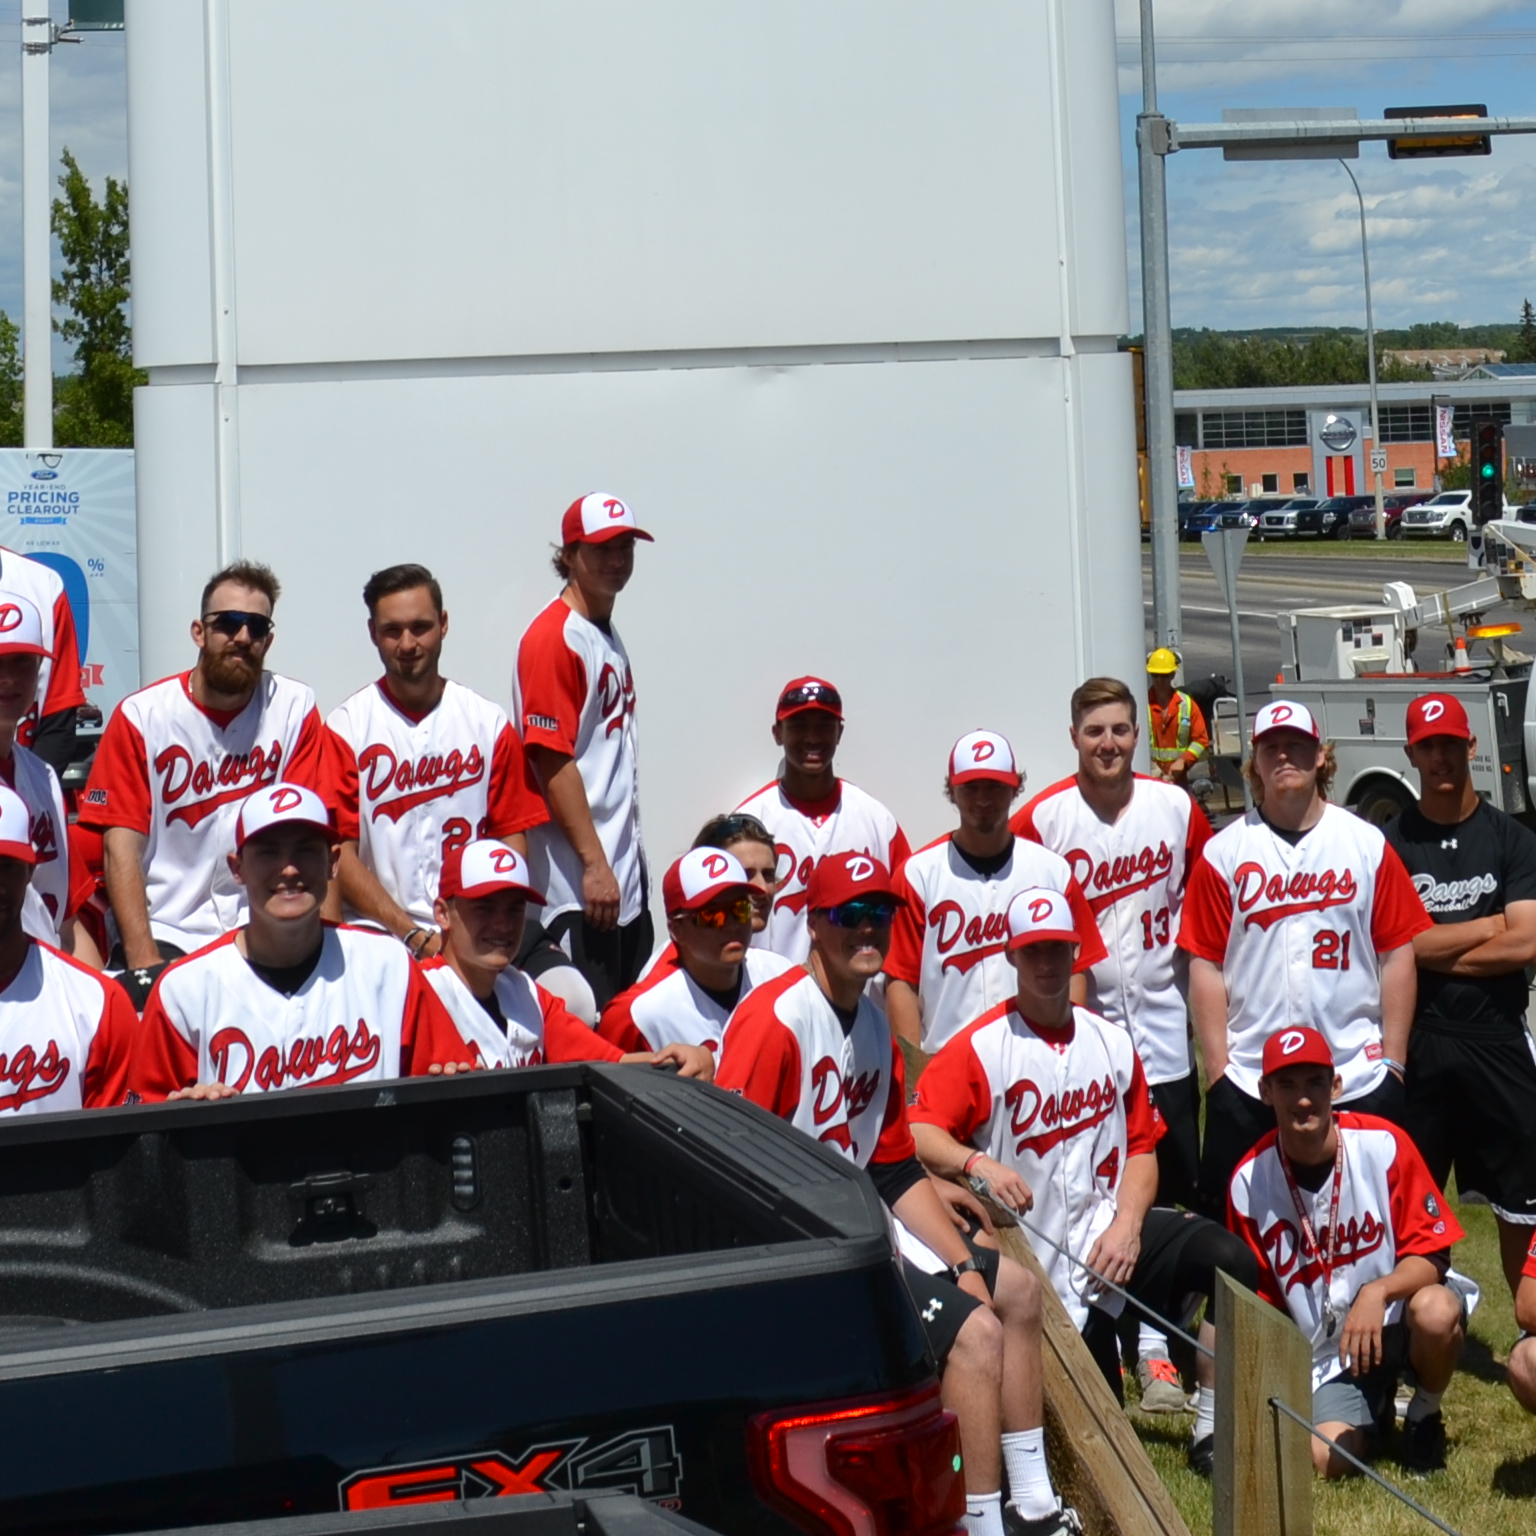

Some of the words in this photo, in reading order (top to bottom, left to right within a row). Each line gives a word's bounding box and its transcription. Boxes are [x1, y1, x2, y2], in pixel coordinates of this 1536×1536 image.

[1372, 457, 1386, 470] 50
[7, 491, 80, 504] PRICING
[7, 504, 80, 515] CLEAROUT
[155, 740, 282, 804] Dawgs
[359, 743, 485, 802] Dawgs
[442, 817, 488, 861] 2
[1065, 841, 1174, 892] Dawgs
[1234, 861, 1357, 913] Dawgs
[1410, 872, 1498, 905] Dawgs
[1141, 906, 1170, 951] 13
[1424, 900, 1470, 913] Baseball
[1311, 929, 1351, 971] 21
[210, 1018, 380, 1094] Dawgs
[1005, 1074, 1117, 1136] Dawgs
[1263, 1211, 1385, 1277] Dawgs
